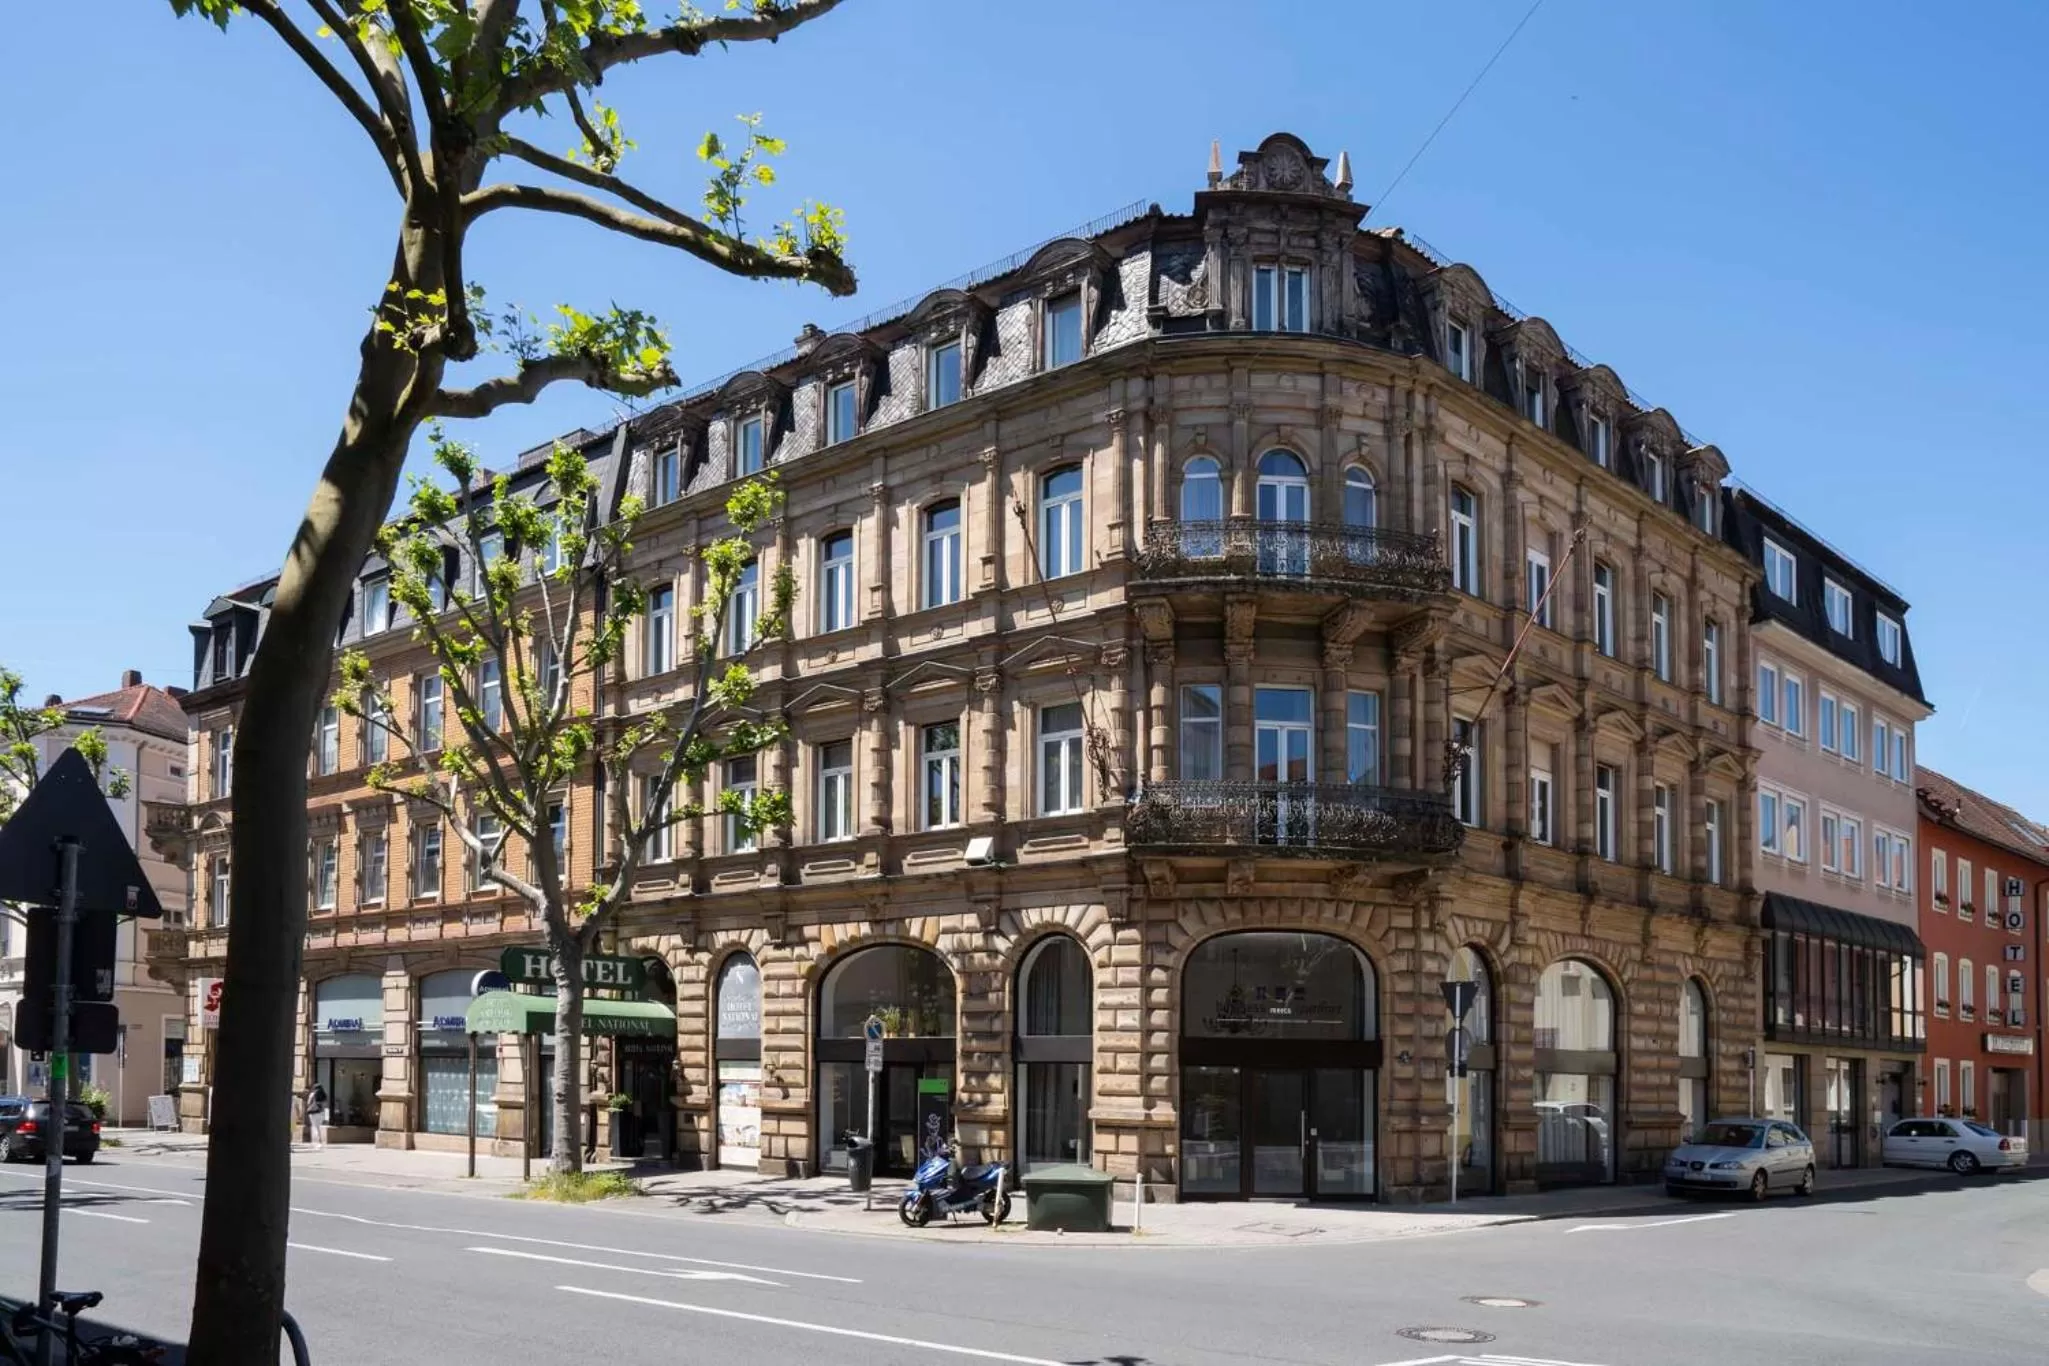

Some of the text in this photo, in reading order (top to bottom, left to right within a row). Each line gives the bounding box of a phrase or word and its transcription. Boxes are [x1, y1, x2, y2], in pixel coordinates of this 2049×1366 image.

[2008, 881, 2021, 1026] HOTEL
[523, 954, 632, 985] HTEL
[598, 1018, 650, 1032] NATIONAL
